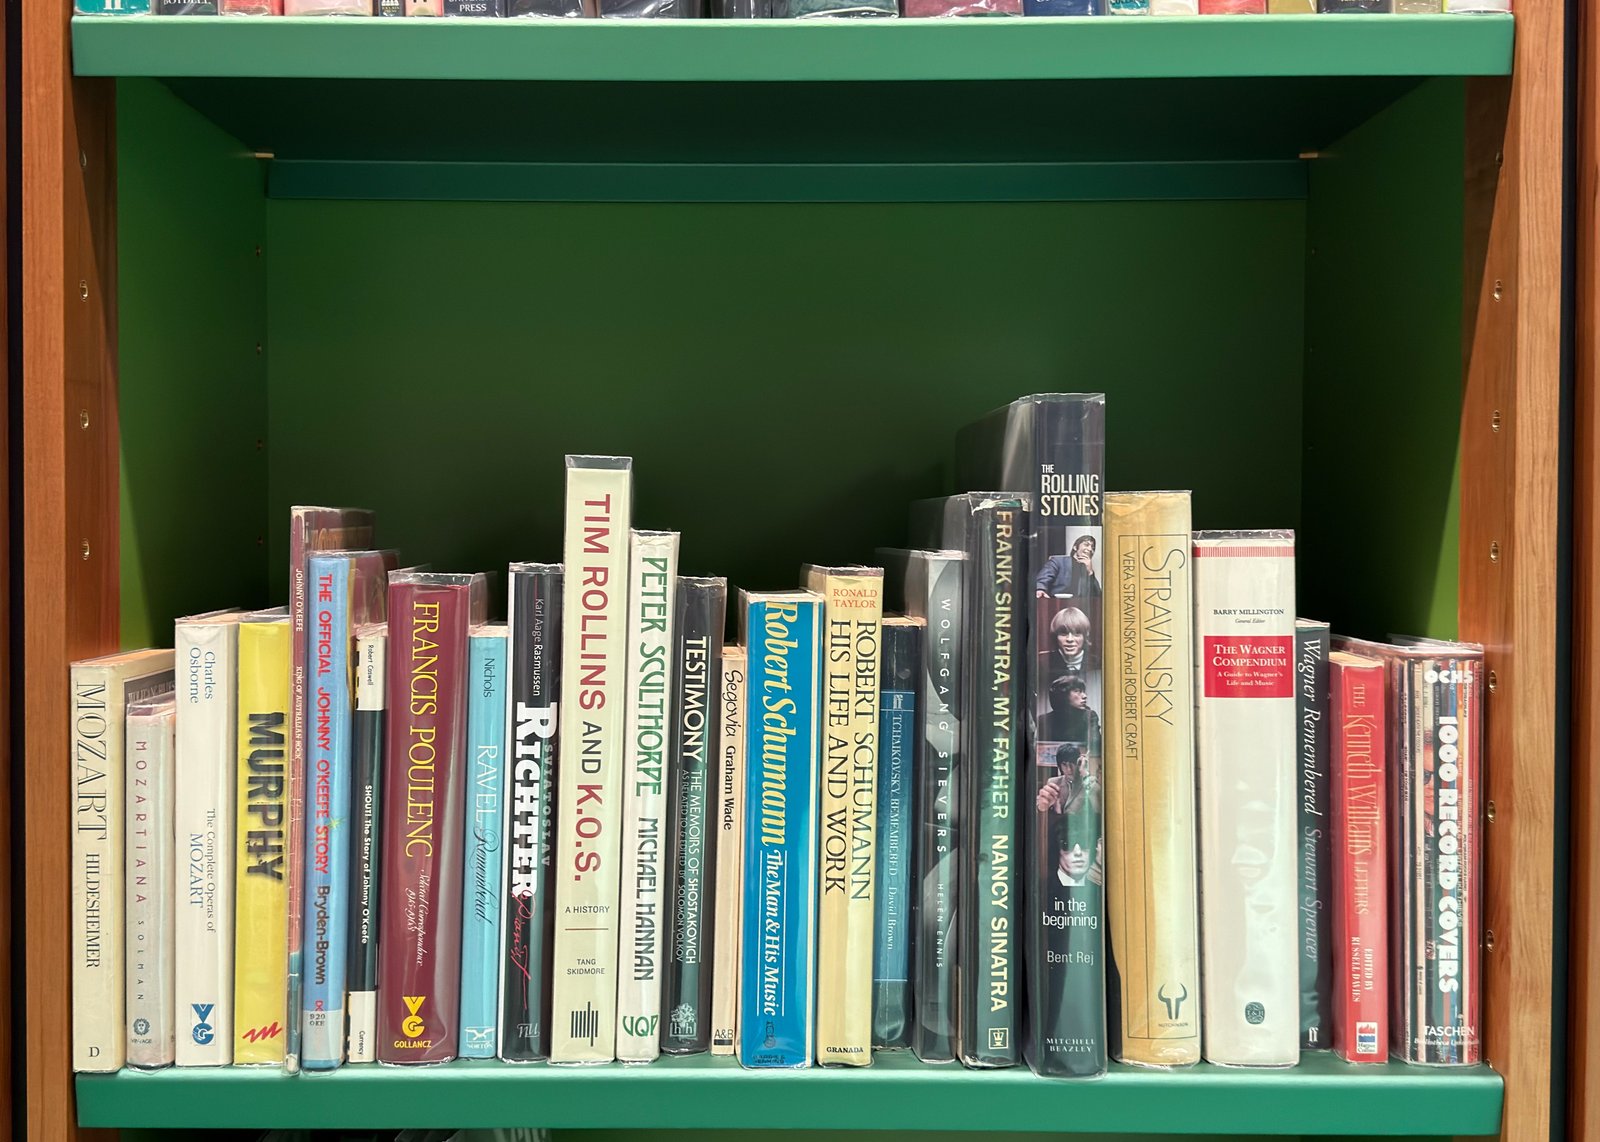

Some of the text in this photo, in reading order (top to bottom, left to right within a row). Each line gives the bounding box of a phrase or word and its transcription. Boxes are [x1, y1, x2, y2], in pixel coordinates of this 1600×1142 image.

[1041, 464, 1055, 474] THE
[1041, 474, 1099, 493] ROLLING
[1041, 494, 1099, 516] STONES
[295, 568, 304, 632] JOHNNY O'KEEFE
[318, 573, 332, 602] THE
[833, 589, 878, 598] RONALD
[833, 600, 877, 608] TAYLOR
[318, 610, 332, 676] OFFICIAL
[366, 645, 375, 686] Robert Caswell
[532, 598, 544, 697] Karl Aage Rasmussen
[1123, 551, 1139, 760] VERA STRAVINSKY And ROBERT CRAFT
[1142, 546, 1186, 725] STRAVINSKY
[1213, 656, 1287, 667] COMPENDIUM
[190, 647, 203, 704] Osborne
[204, 651, 216, 700] Charles
[483, 658, 496, 698] Nichols
[574, 493, 610, 881] TIM ROLLINS AND K.O.S.
[1424, 670, 1473, 683] OCHS
[294, 665, 303, 760] KING OF AUSTRALIAN ROCK
[317, 686, 331, 751] JOHNNY
[405, 600, 440, 858] FRANCIS POULENC
[761, 601, 799, 846] Robert Schumann
[633, 557, 667, 981] PETER SCULTHORPE MICHAEL HANNAN
[722, 669, 744, 831] Segovia Graham Wade
[825, 619, 852, 896] HIS LIFE AND WORK
[851, 619, 877, 900] ROBERT SCHUMANN
[936, 598, 952, 968] WOLFGANG SIEVERS HELEN ENNIS
[991, 510, 1013, 1012] FRANK SINATRA, MY FATHER NANCY SINATRA
[246, 712, 286, 881] MURPHY
[316, 759, 330, 818] O'KEEFE
[512, 702, 558, 898] RICHTER
[541, 744, 553, 867] SVIATOSLAV
[683, 636, 707, 964] TESTIMONY THE MEMOIRS OF SHOSTAKOVICH
[1298, 639, 1323, 963] Wagner Remembered Stewart Spencer
[1343, 684, 1382, 915] THE Kenneth Williams LETTERS
[77, 680, 107, 969] MOZART HILDESHEIMER
[315, 826, 329, 874] STORY
[469, 744, 500, 927] RAVEL Remembered
[886, 713, 902, 950] TCHAIKOVSKY REMEMBERED David Brown
[1437, 716, 1459, 993] 1000 RECORD COVERS
[135, 741, 147, 1000] MOZARTIANA SOLMAN
[190, 833, 204, 908] MOZART
[204, 808, 217, 933] The Complete Operas of
[361, 785, 373, 944] SHOUT! The Story of Johnny O'Keefe
[417, 869, 431, 903] Selected
[315, 885, 331, 985] Bryden-Brown
[573, 905, 610, 913] HISTORY
[677, 885, 686, 925] SOLOMON
[764, 850, 784, 1016] The Man & His Music
[1042, 912, 1098, 929] beginning
[1054, 897, 1087, 912] in the
[675, 928, 684, 962] VOLKOV
[1047, 951, 1095, 966] Bent Rej
[1351, 936, 1361, 1003] RUSSELL DAVIES
[1364, 948, 1374, 990] EDITED BY
[88, 1046, 100, 1058] D
[394, 1040, 432, 1049] GOLLANCZ
[622, 1014, 659, 1037] UQP
[714, 1029, 733, 1039] A&B
[826, 1046, 864, 1054] GRANADA
[1424, 1025, 1475, 1037] TASCHEN
